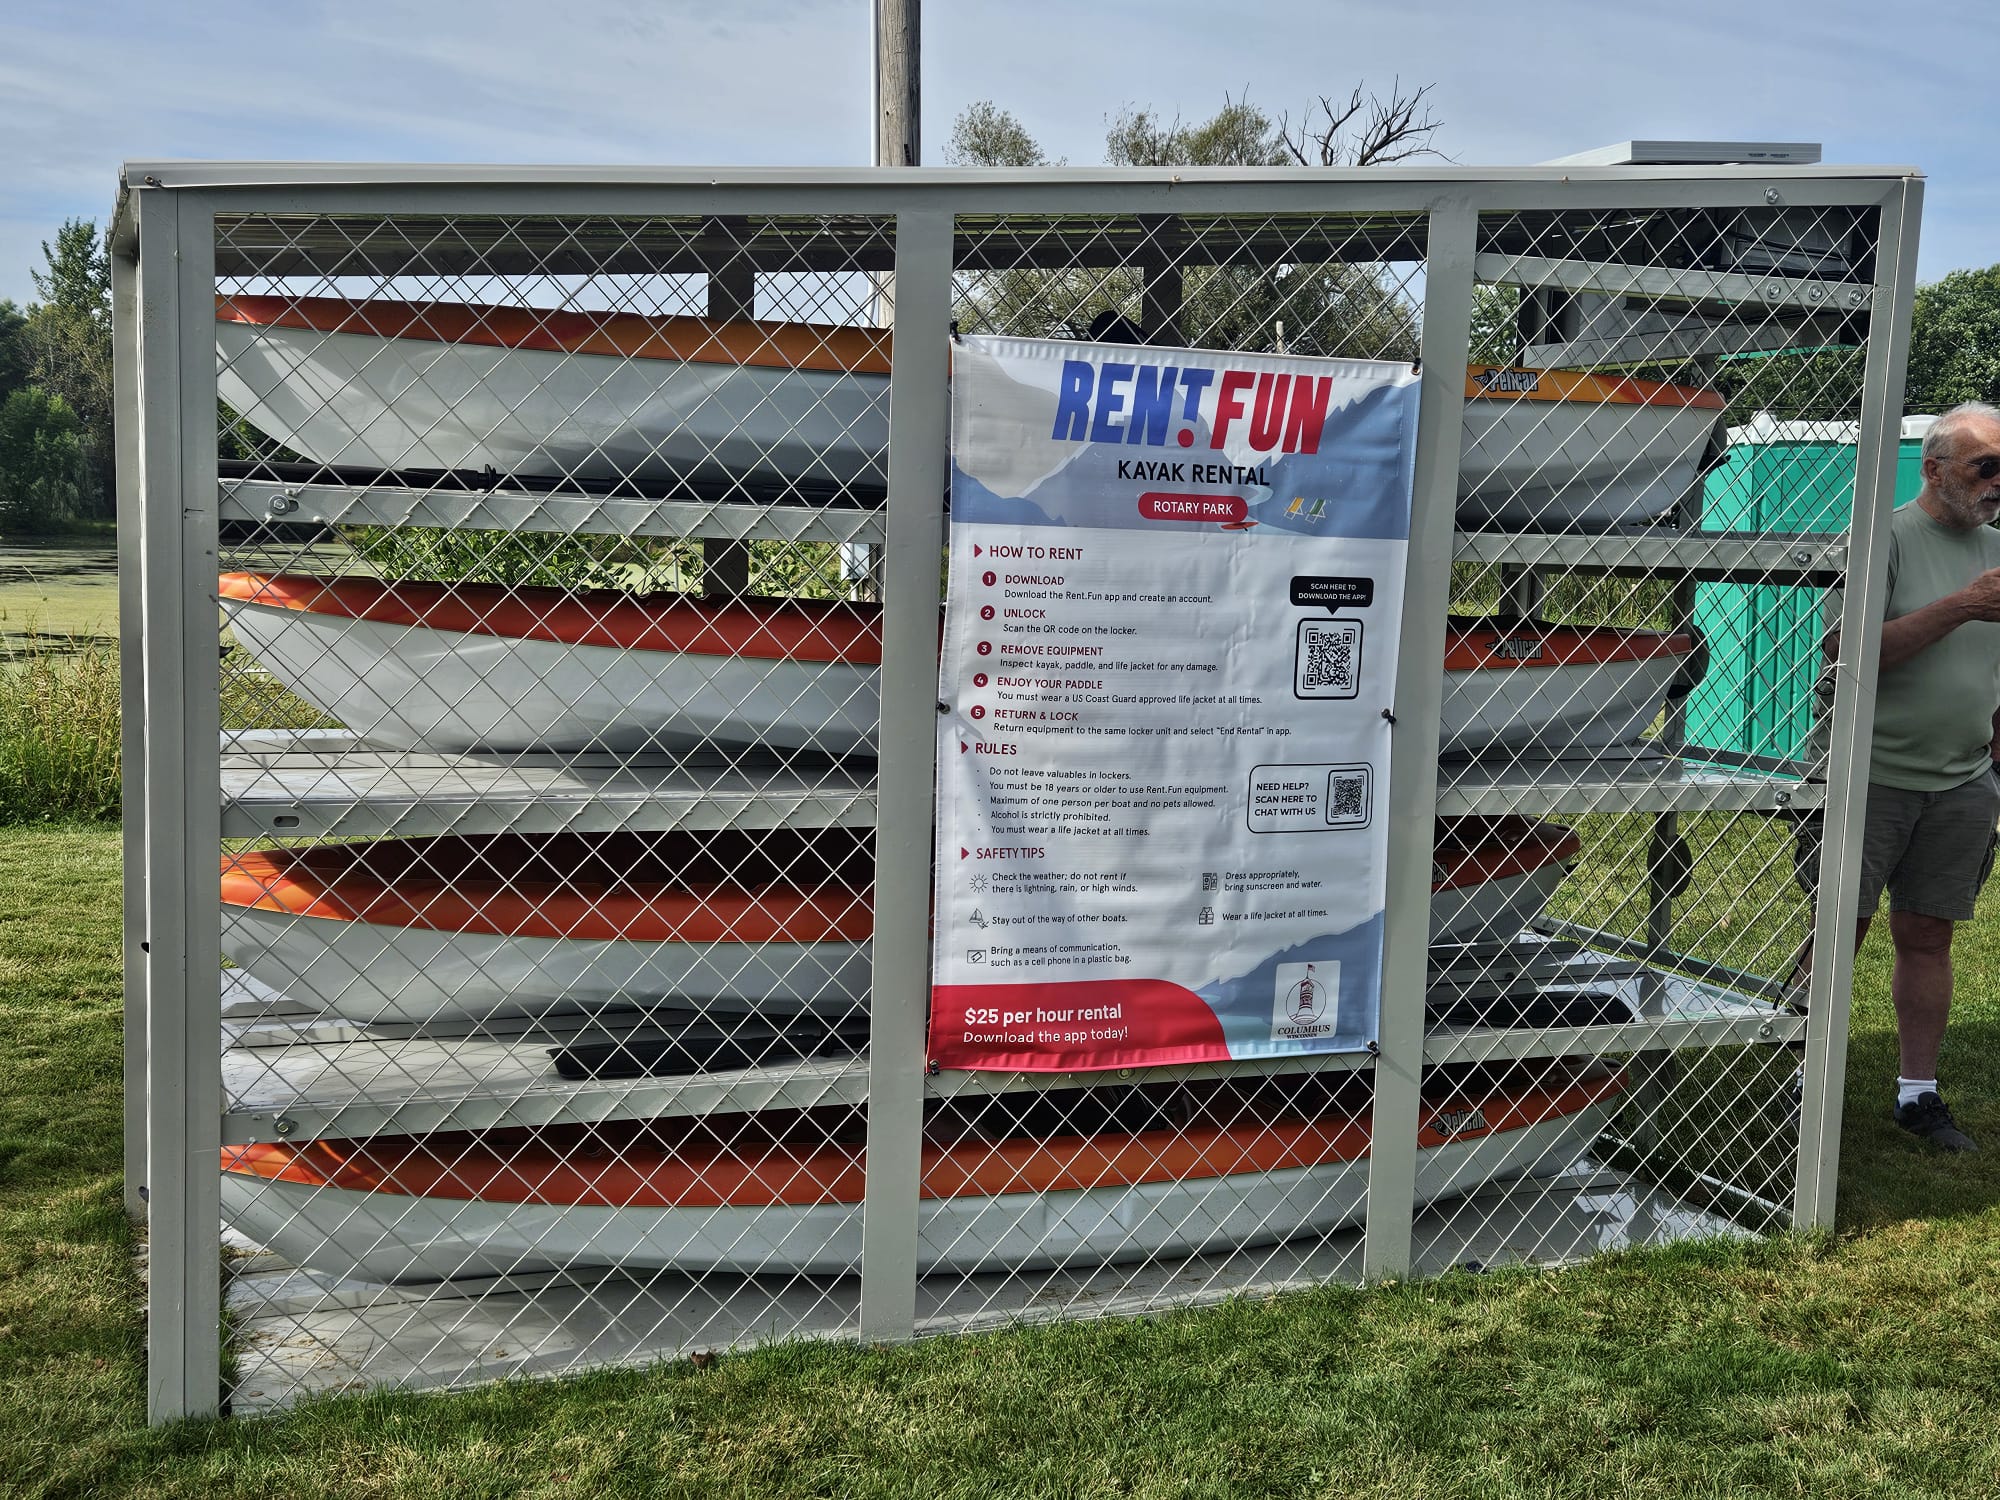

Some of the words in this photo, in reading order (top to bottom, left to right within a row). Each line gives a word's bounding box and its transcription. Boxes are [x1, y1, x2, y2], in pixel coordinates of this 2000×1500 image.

[1484, 368, 1539, 392] Pelican
[1118, 459, 1185, 482] KAYAK
[1192, 463, 1270, 486] RENTAL
[1153, 500, 1199, 513] ROTARY
[1203, 502, 1232, 515] PARK
[989, 545, 1023, 558] HOW
[1026, 546, 1045, 559] TO
[1049, 547, 1083, 560] RENT
[1005, 574, 1064, 585] DOWNLOAD
[1004, 589, 1046, 599] Download
[1049, 590, 1063, 599] the
[1065, 590, 1102, 600] Rent.Fun
[1104, 593, 1120, 603] app
[1122, 592, 1136, 601] and
[1139, 593, 1165, 602] create
[1178, 595, 1213, 603] account.
[1003, 608, 1046, 618] UNLOCK
[1002, 623, 1024, 632] Scan
[1026, 624, 1041, 632] the
[1043, 624, 1055, 633] QR
[1058, 625, 1079, 634] code
[1094, 625, 1108, 634] the
[1110, 625, 1137, 635] locker.
[1000, 644, 1044, 655] REMOVE
[1046, 645, 1103, 656] EQUIPMENT
[999, 658, 1033, 669] Inspect
[1035, 659, 1062, 670] kayak,
[1064, 660, 1095, 671] paddle,
[1097, 661, 1113, 669] and
[1115, 661, 1128, 670] life
[1129, 661, 1154, 671] jacket
[1156, 661, 1168, 670] for
[1170, 664, 1184, 672] any
[1185, 662, 1218, 673] damage.
[997, 676, 1032, 687] ENJOY
[1034, 678, 1062, 688] YOUR
[1065, 679, 1103, 689] PADDLE
[997, 690, 1013, 699] You
[1016, 693, 1038, 701] must
[1072, 693, 1083, 702] US
[1085, 694, 1109, 703] Coast
[1111, 694, 1136, 703] Guard
[1138, 695, 1176, 705] approved
[1178, 695, 1190, 703] life
[1191, 695, 1216, 705] jacket
[1218, 695, 1226, 703] at
[1227, 695, 1237, 703] all
[1238, 695, 1262, 703] times.
[994, 708, 1036, 719] RETURN
[1039, 711, 1046, 720] &
[1049, 711, 1079, 721] LOCK
[975, 742, 1016, 755] RULES
[989, 766, 1001, 775] Do
[1003, 767, 1018, 775] not
[1021, 767, 1044, 777] leave
[1046, 769, 1086, 779] valuables
[1089, 770, 1096, 779] in
[1099, 770, 1131, 780] lockers.
[989, 781, 1003, 790] You
[1006, 782, 1027, 790] must
[1030, 782, 1042, 791] be
[1045, 783, 1053, 791] 18
[1056, 785, 1079, 793] years
[1093, 785, 1116, 793] older
[1118, 785, 1127, 793] to
[1146, 785, 1182, 793] Rent.Fun
[1184, 785, 1228, 795] equipment.
[1256, 782, 1280, 791] NEED
[1282, 782, 1309, 790] HELP?
[1255, 795, 1279, 803] SCAN
[1281, 794, 1304, 803] HERE
[1305, 794, 1317, 802] TO
[990, 810, 1019, 819] Alcohol
[1021, 810, 1028, 819] is
[1030, 810, 1061, 821] strictly
[1062, 812, 1110, 821] prohibited.
[1254, 808, 1278, 816] CHAT
[1279, 807, 1303, 815] WITH
[1304, 807, 1316, 815] US
[991, 825, 1004, 833] You
[1006, 825, 1025, 834] must
[1058, 825, 1071, 834] life
[1073, 825, 1100, 836] jacket
[1102, 827, 1111, 835] at
[1113, 827, 1123, 836] all
[1125, 825, 1150, 837] times.
[976, 847, 1019, 859] SAFETY
[1020, 847, 1045, 859] TIPS
[991, 872, 1017, 881] Check
[1019, 872, 1031, 880] the
[1032, 871, 1067, 880] weather;
[1070, 871, 1081, 880] do
[1083, 872, 1097, 880] not
[1099, 872, 1117, 880] rent
[1225, 871, 1247, 880] Dress
[991, 884, 1014, 893] there
[1091, 883, 1109, 893] high
[1111, 882, 1138, 892] winds.
[1224, 882, 1244, 893] bring
[1245, 882, 1284, 891] sunscreen
[1285, 880, 1300, 888] and
[1300, 880, 1322, 888] water.
[991, 916, 1010, 926] Stay
[1011, 915, 1025, 924] out
[1027, 914, 1035, 924] of
[1037, 914, 1049, 923] the
[1051, 916, 1065, 924] way
[1066, 913, 1075, 922] of
[1077, 913, 1100, 922] other
[1102, 913, 1127, 922] boats.
[1222, 912, 1242, 921] Wear
[1250, 911, 1262, 919] life
[1263, 911, 1286, 921] jacket
[1287, 910, 1295, 918] at
[1297, 909, 1305, 917] all
[1307, 908, 1328, 917] times.
[964, 1007, 998, 1025] $25
[1003, 1011, 1032, 1027] per
[1036, 1007, 1074, 1022] hour
[1077, 1002, 1121, 1020] rental
[963, 1030, 1033, 1042] Download
[1038, 1030, 1060, 1042] the
[1064, 1031, 1087, 1044] app
[1090, 1025, 1129, 1041] today!
[1277, 1024, 1331, 1035] COLUMBUS
